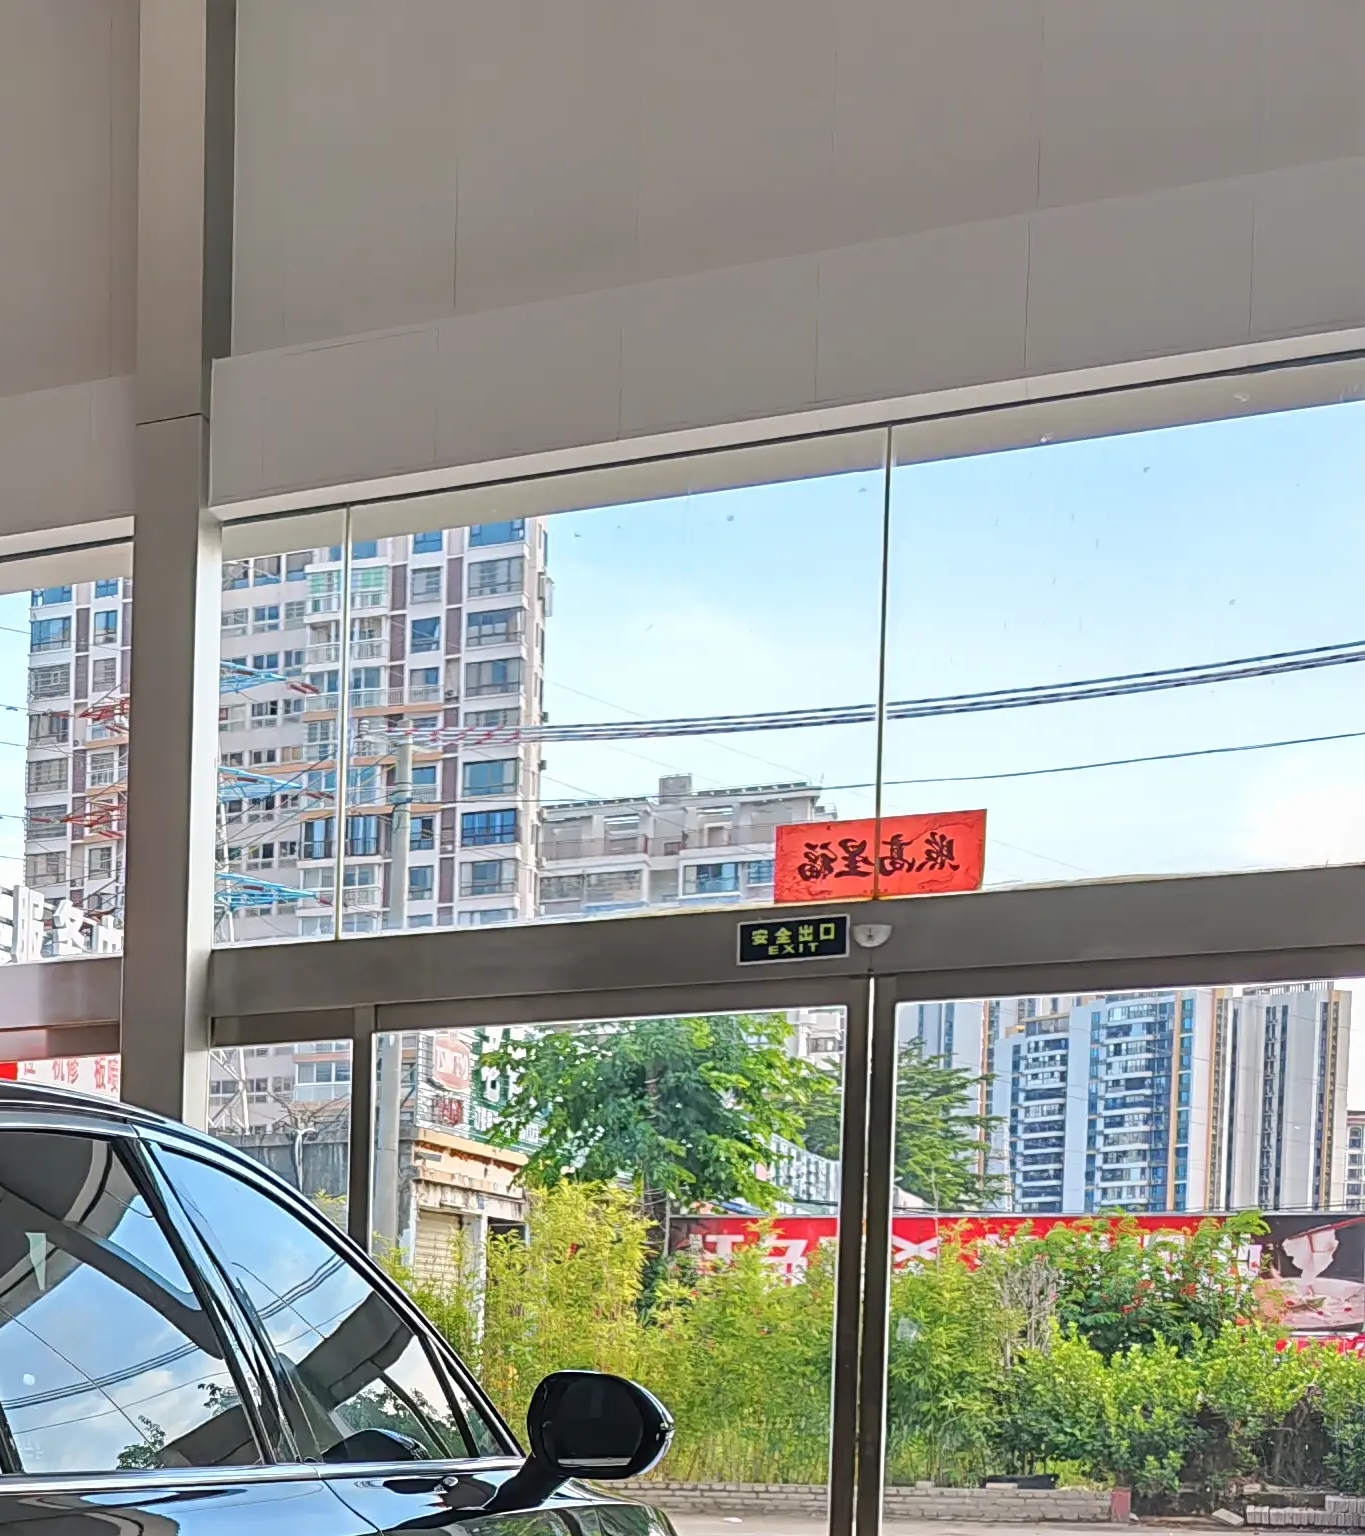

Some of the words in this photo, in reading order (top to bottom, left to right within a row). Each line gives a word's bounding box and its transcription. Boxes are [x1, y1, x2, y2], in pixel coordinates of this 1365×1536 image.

[751, 923, 836, 946] 安全出口
[767, 942, 820, 956] EXIT
